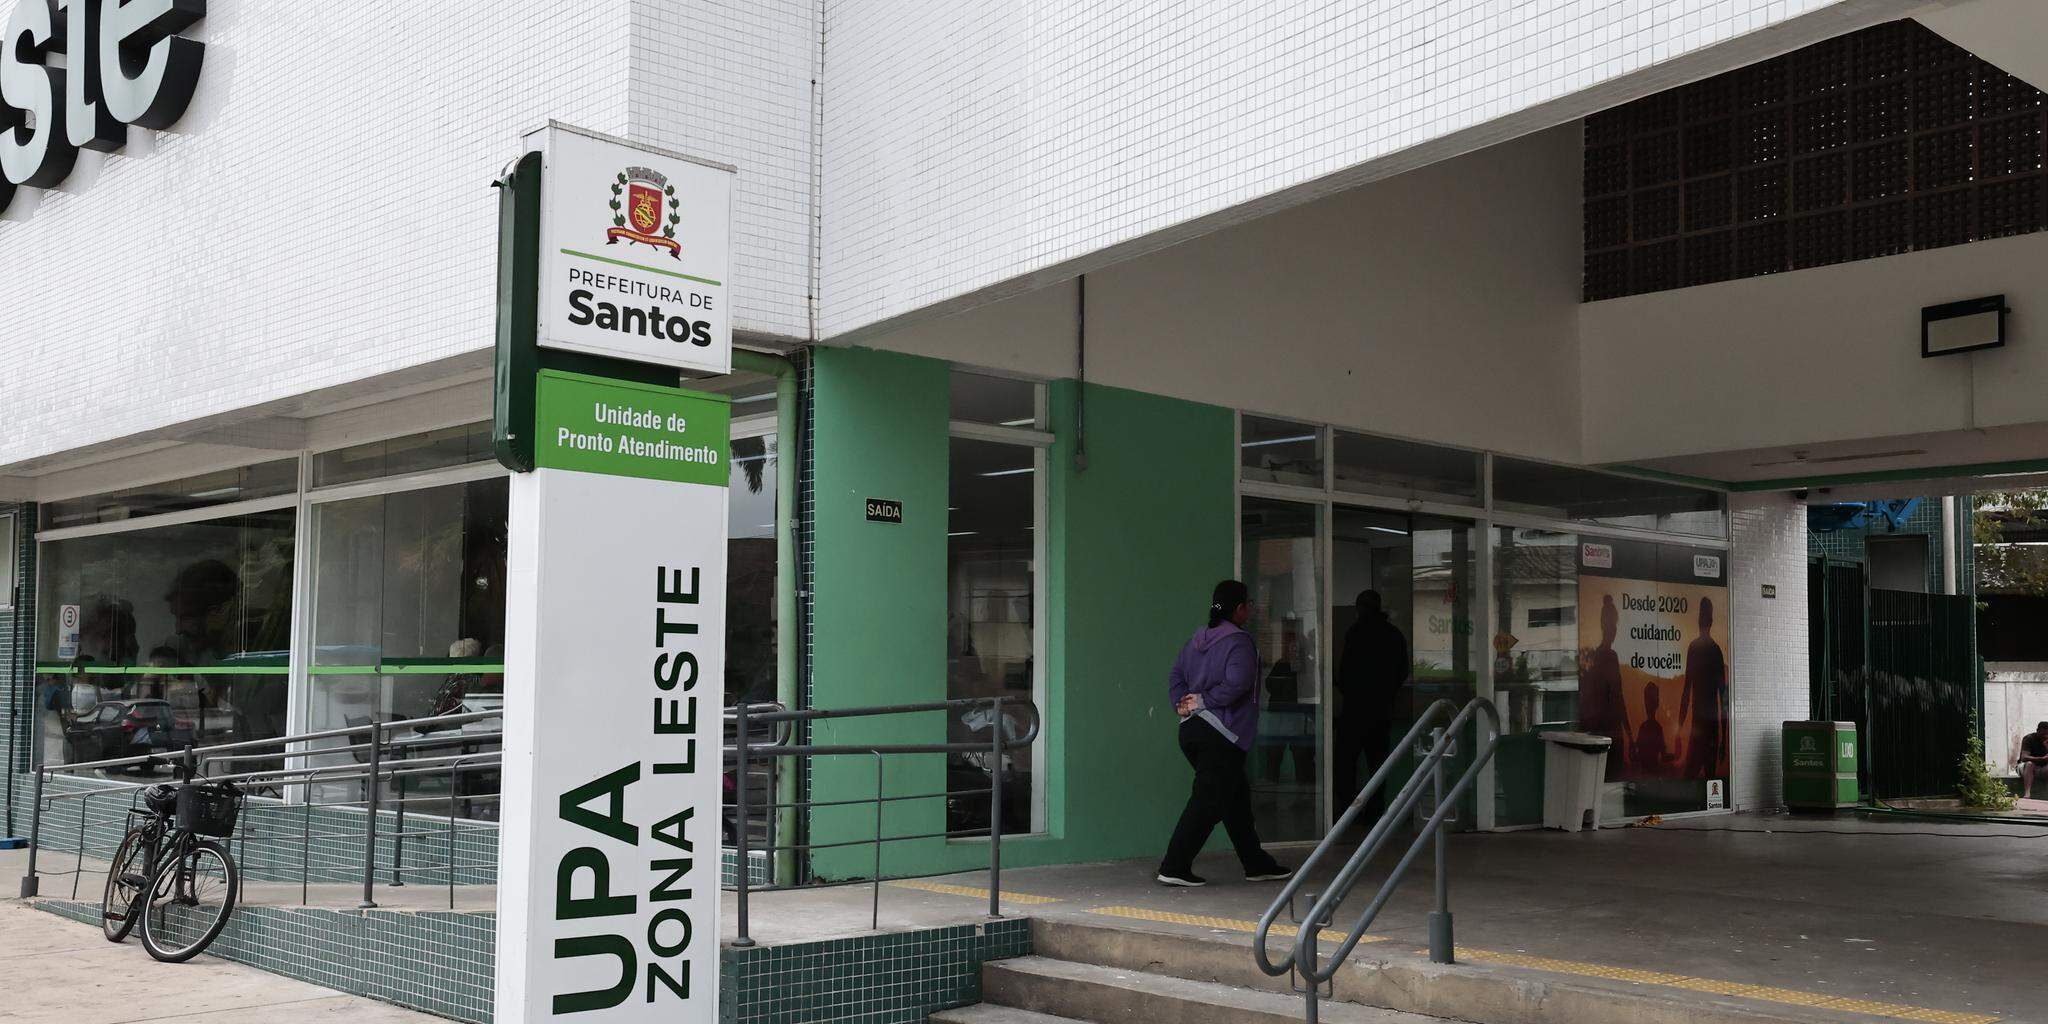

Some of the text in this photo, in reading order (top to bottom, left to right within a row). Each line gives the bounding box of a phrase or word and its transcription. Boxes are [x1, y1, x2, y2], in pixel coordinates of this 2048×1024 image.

[569, 268, 713, 310] PREFEITURA DE
[568, 289, 712, 348] Santos
[595, 402, 686, 433] Unidade de
[558, 427, 718, 465] Pronto Atendimento
[867, 502, 901, 518] SAÍDA
[1622, 593, 1688, 614] Desde 2020
[1630, 624, 1682, 641] cuidando
[1631, 652, 1645, 669] de
[646, 566, 700, 1003] ZONA LESTE
[552, 760, 641, 1015] UPA
